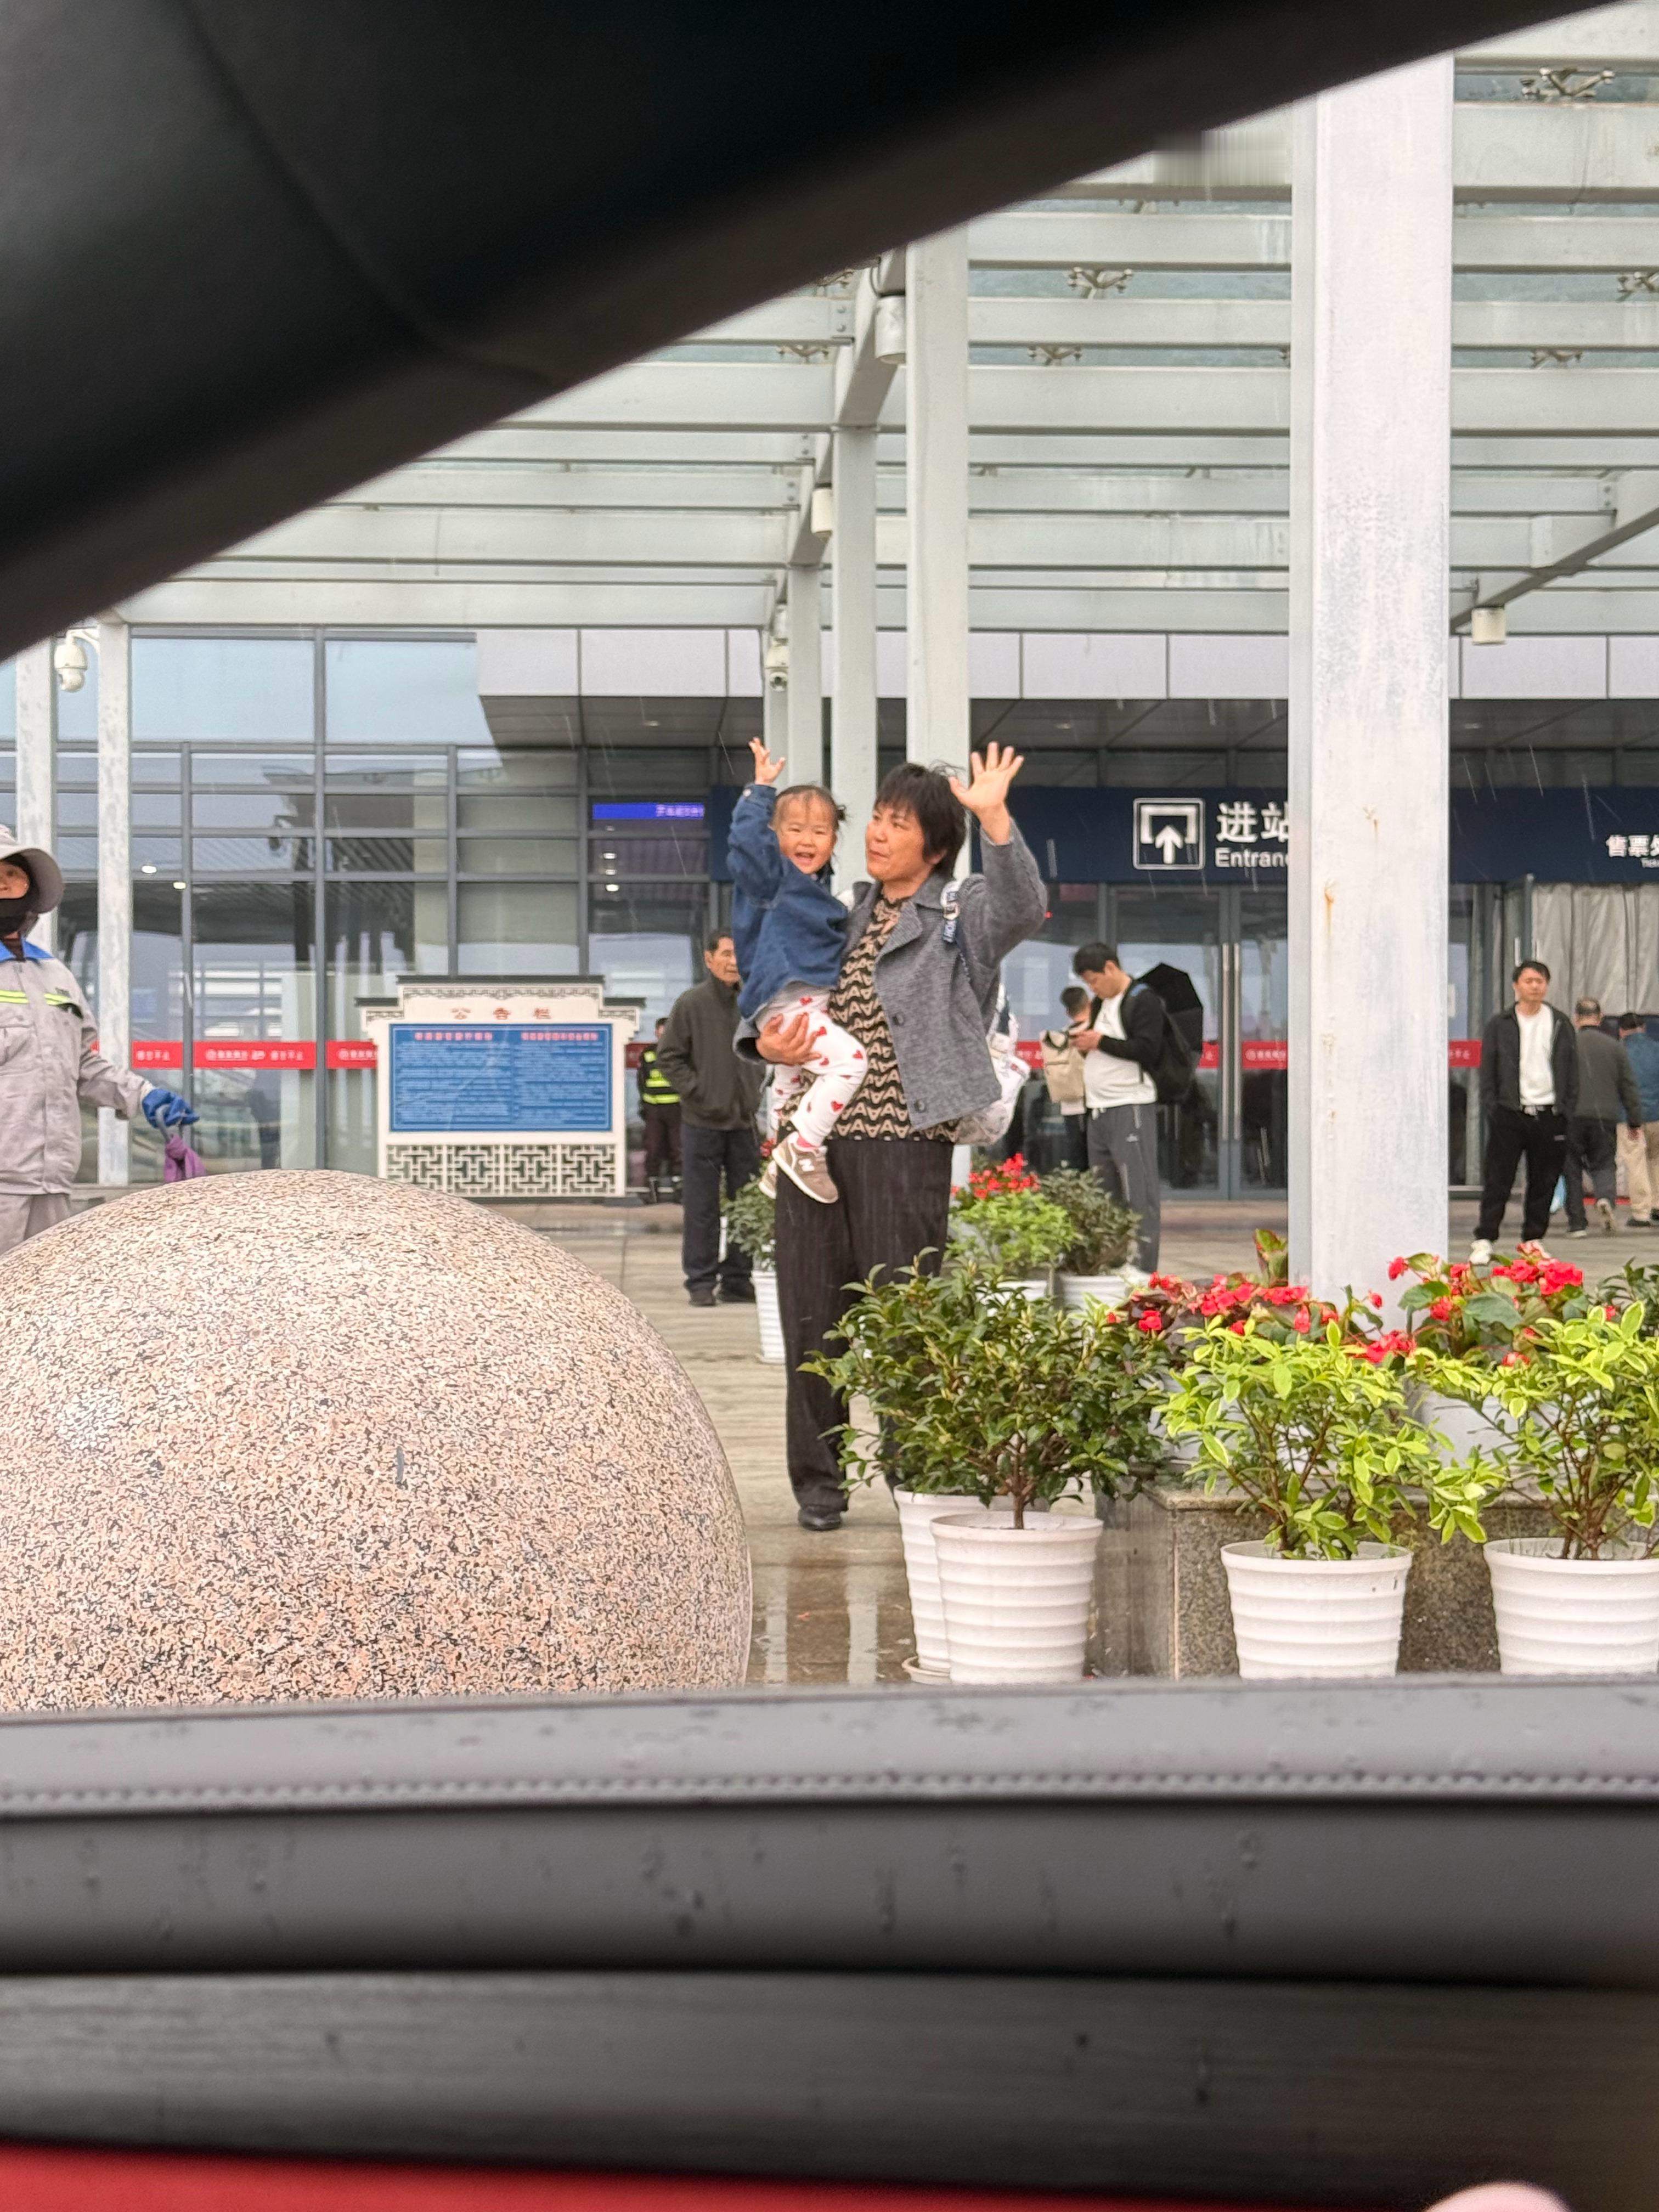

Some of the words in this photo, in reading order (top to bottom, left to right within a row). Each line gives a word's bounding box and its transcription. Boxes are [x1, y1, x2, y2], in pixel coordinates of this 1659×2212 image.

[1215, 847, 1288, 867] Entran
[450, 1007, 551, 1020] 公告栏
